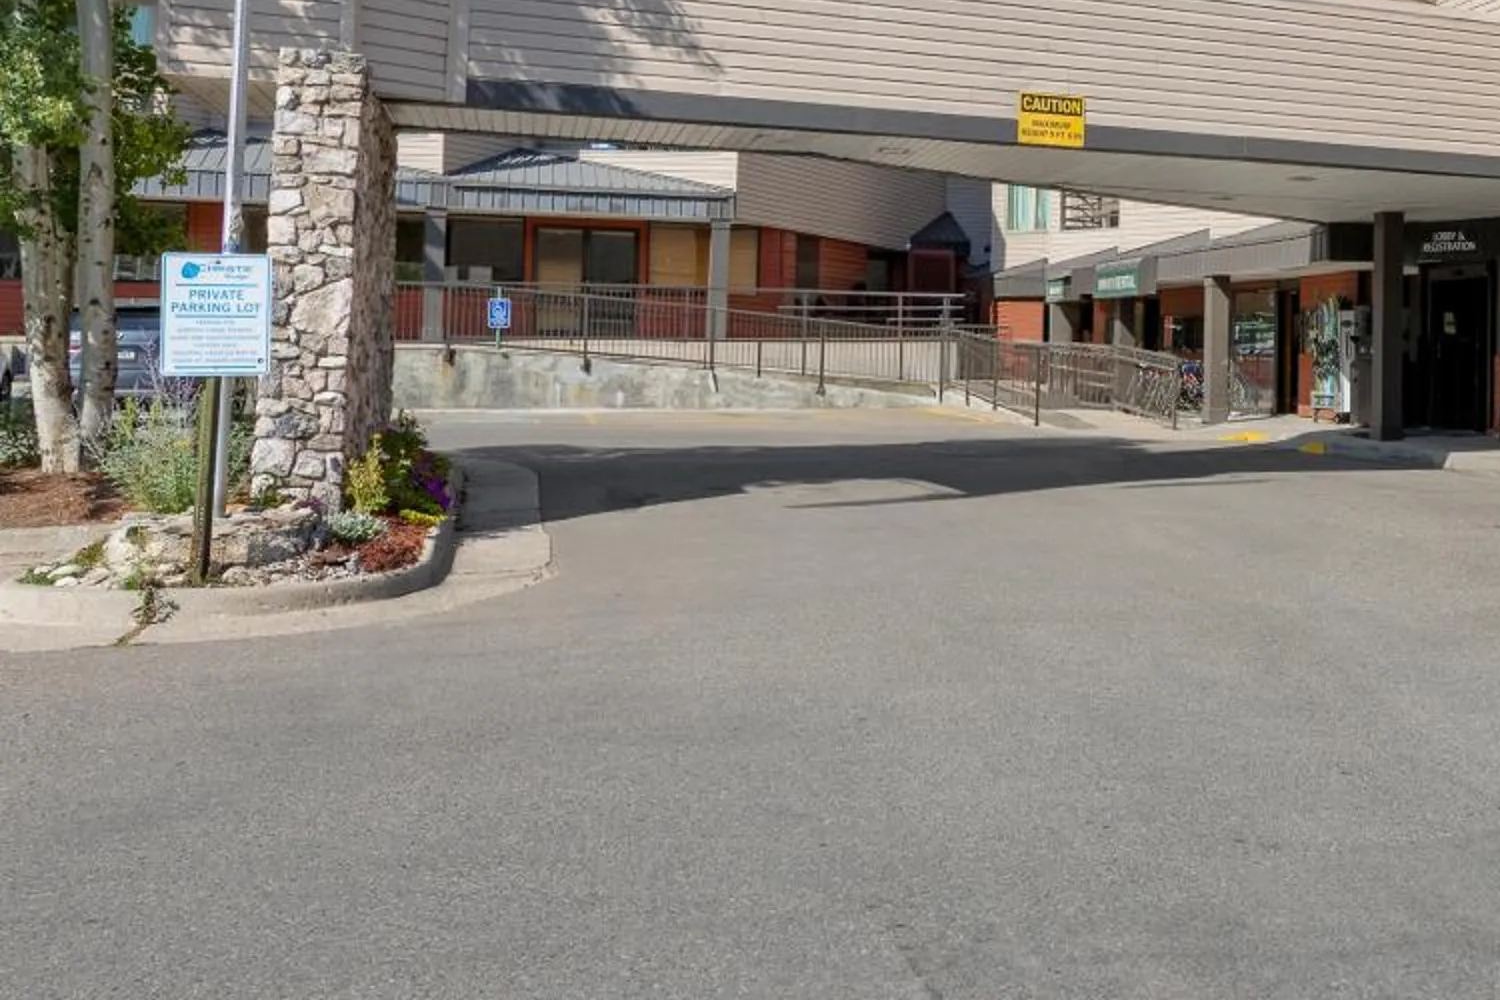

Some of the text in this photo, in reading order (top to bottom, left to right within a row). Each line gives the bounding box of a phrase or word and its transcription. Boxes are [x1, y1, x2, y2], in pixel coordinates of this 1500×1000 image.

[1023, 96, 1081, 114] CAUTION
[189, 289, 245, 301] PRIVATE
[171, 302, 260, 313] PARKING LOT
